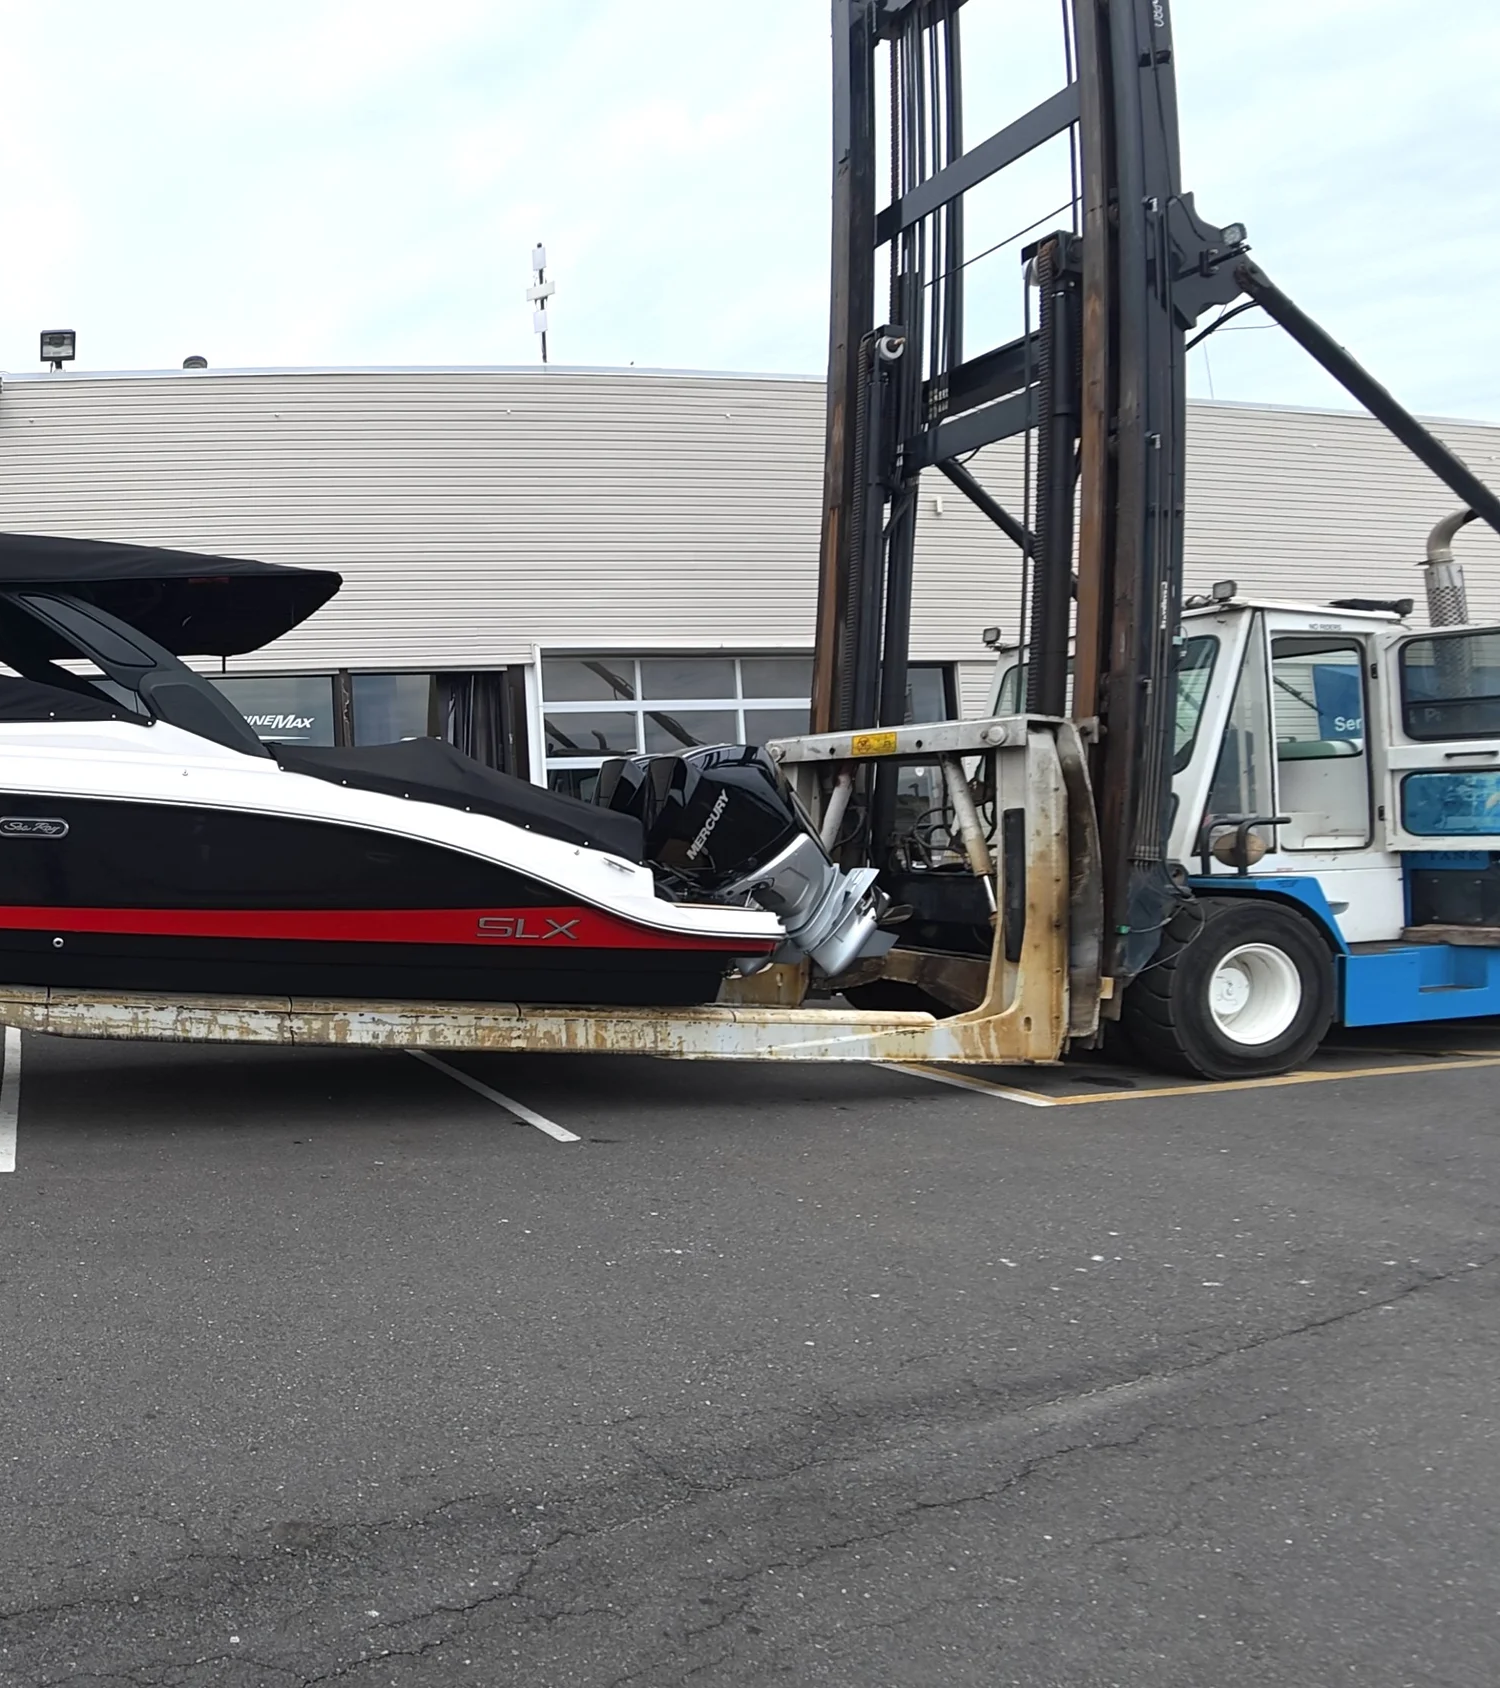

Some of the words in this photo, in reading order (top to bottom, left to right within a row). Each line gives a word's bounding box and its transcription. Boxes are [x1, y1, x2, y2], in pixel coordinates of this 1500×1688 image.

[3, 822, 32, 831] Sea
[32, 822, 61, 835] Ray
[686, 788, 729, 861] MERCURY
[476, 917, 581, 940] SLX
